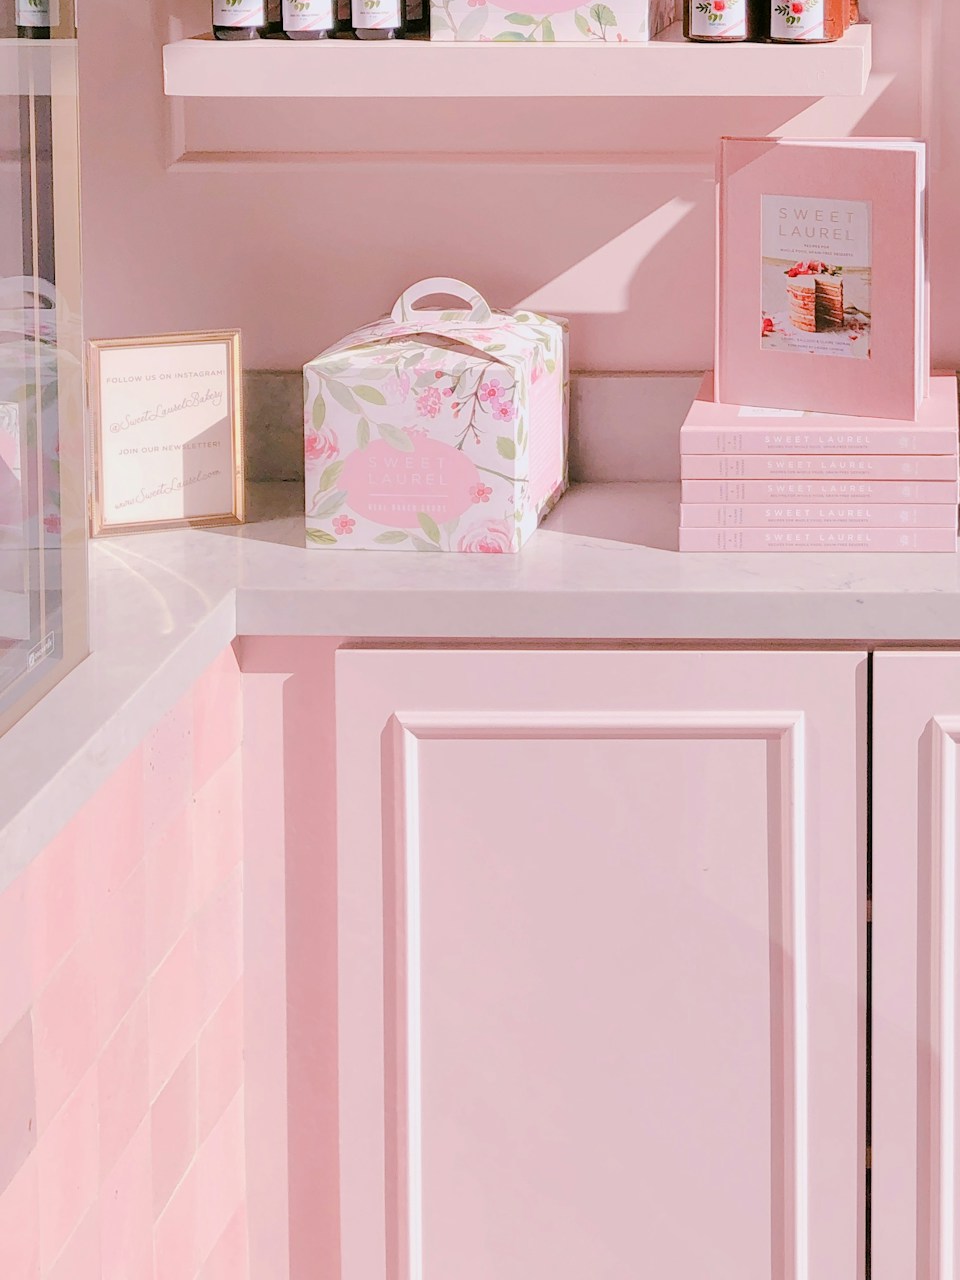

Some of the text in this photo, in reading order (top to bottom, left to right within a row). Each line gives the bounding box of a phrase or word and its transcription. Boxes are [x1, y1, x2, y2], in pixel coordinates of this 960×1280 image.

[778, 207, 855, 224] SWEET
[778, 224, 855, 241] LAUREL
[107, 375, 142, 383] FOLLOW
[174, 369, 226, 379] INSTAGRAM!
[109, 388, 223, 433] @SweetLaurelBakery
[141, 446, 159, 454] OUR
[161, 440, 221, 452] NEWSLETTER!
[368, 457, 445, 469] SWEET
[368, 473, 448, 485] LAUREL
[765, 509, 872, 517] SWEET LAUREL
